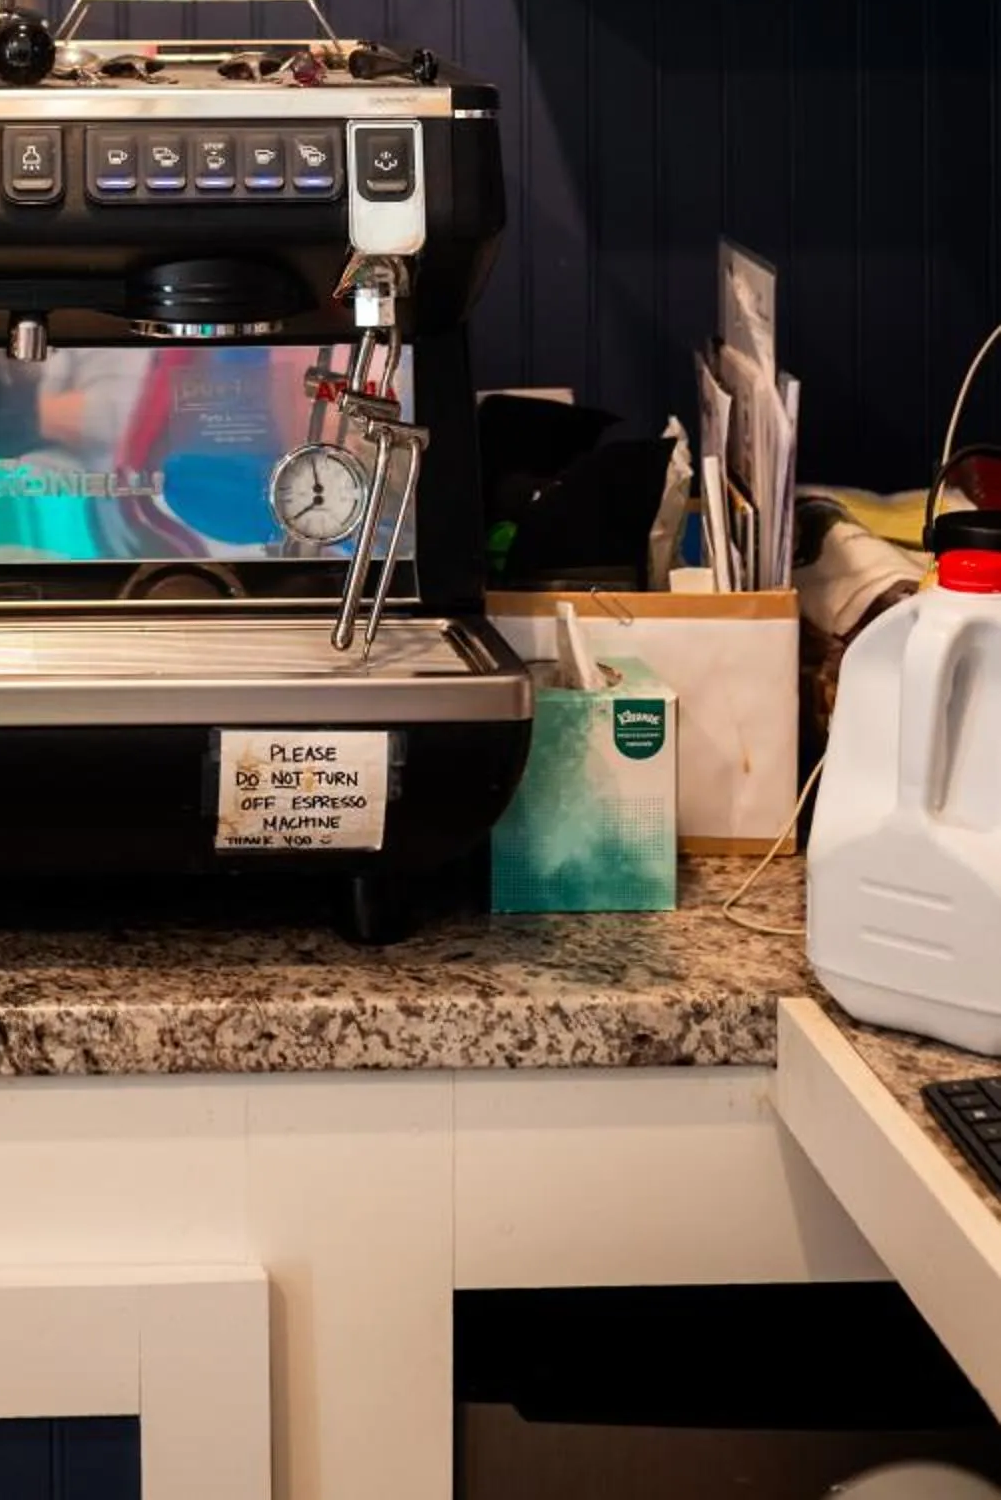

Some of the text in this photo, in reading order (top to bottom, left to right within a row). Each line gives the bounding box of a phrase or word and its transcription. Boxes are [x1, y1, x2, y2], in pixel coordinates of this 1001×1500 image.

[270, 744, 338, 762] PLEASE
[236, 771, 358, 787] DO NOT TURN
[241, 796, 367, 810] OFF ESPRESSO
[263, 815, 341, 832] MACHINE
[224, 835, 313, 846] THANK YOU
